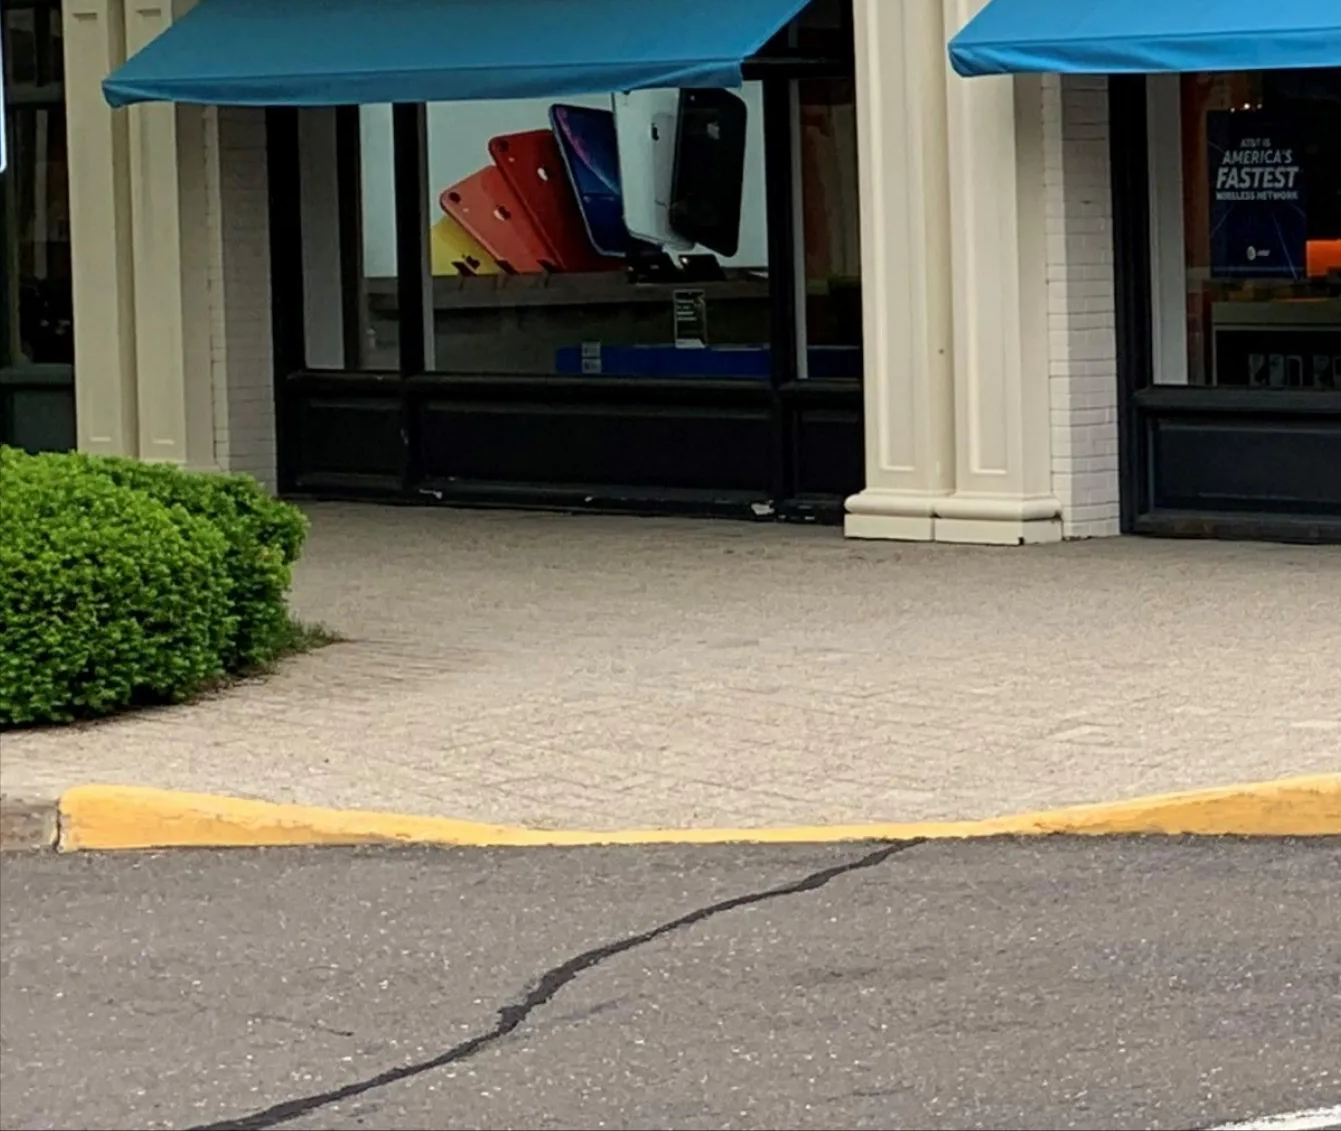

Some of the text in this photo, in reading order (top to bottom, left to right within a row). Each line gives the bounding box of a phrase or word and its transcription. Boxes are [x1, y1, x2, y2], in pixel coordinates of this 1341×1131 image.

[1222, 149, 1293, 165] AMERICA'S
[1216, 166, 1300, 189] FASTEST
[1256, 191, 1299, 201] NETWORK
